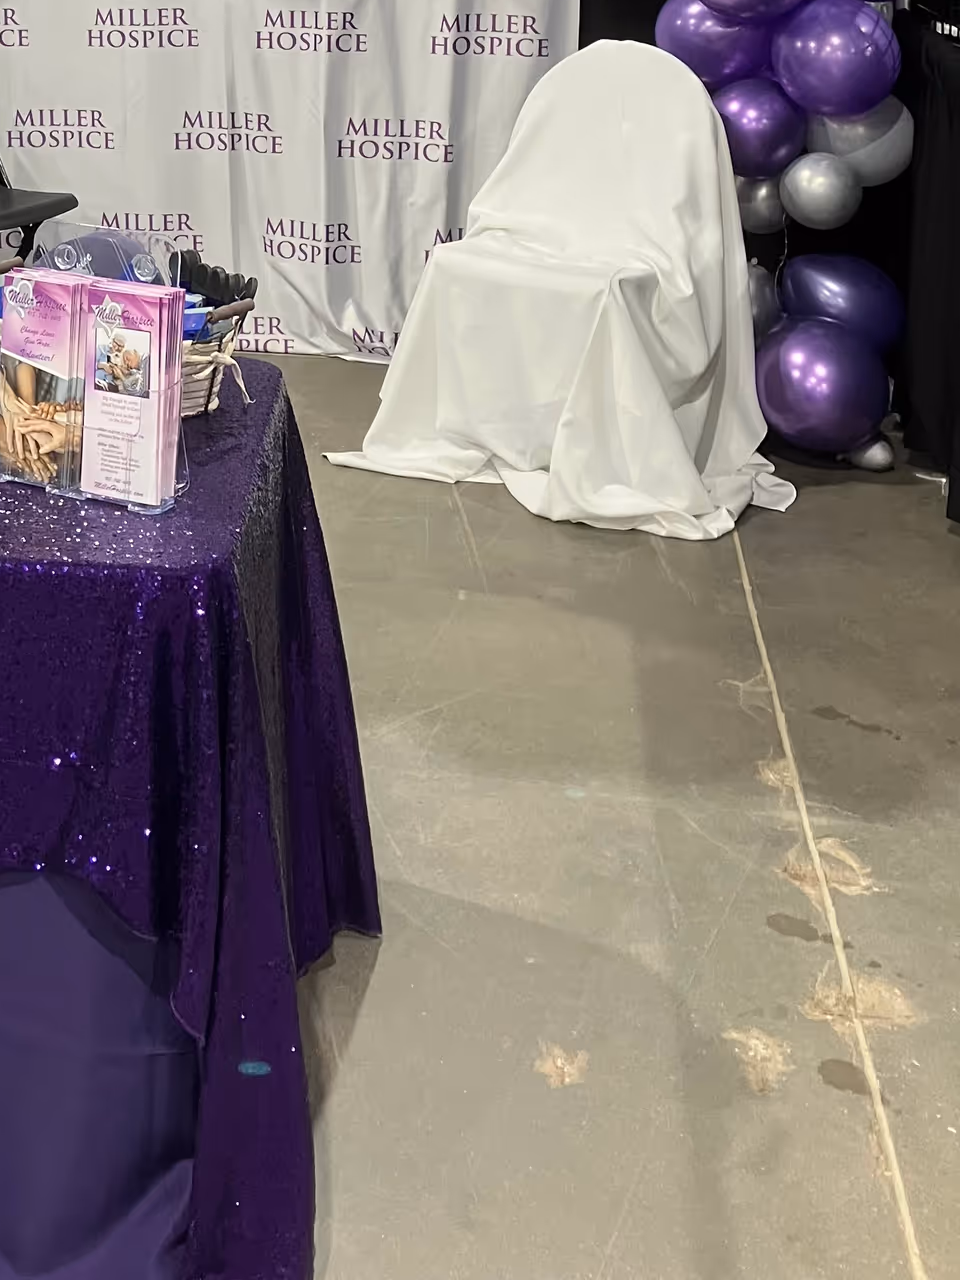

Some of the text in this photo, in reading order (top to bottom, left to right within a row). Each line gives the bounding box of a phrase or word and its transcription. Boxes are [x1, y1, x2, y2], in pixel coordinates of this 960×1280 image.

[94, 7, 190, 28] MILLER
[263, 9, 359, 31] MILLER
[439, 13, 542, 35] MILLER
[87, 29, 200, 49] HOSPICE
[255, 31, 368, 53] HOSPICE
[430, 35, 550, 58] HOSPICE
[13, 108, 107, 128] MILLER
[182, 110, 273, 133] MILLER
[345, 117, 447, 141] MILLER
[6, 129, 115, 150] HOSPICE
[173, 131, 284, 155] HOSPICE
[336, 139, 455, 164] HOSPICE
[100, 211, 194, 232] MILLER
[265, 217, 355, 243] MILLER
[261, 236, 363, 266] HOSPICE
